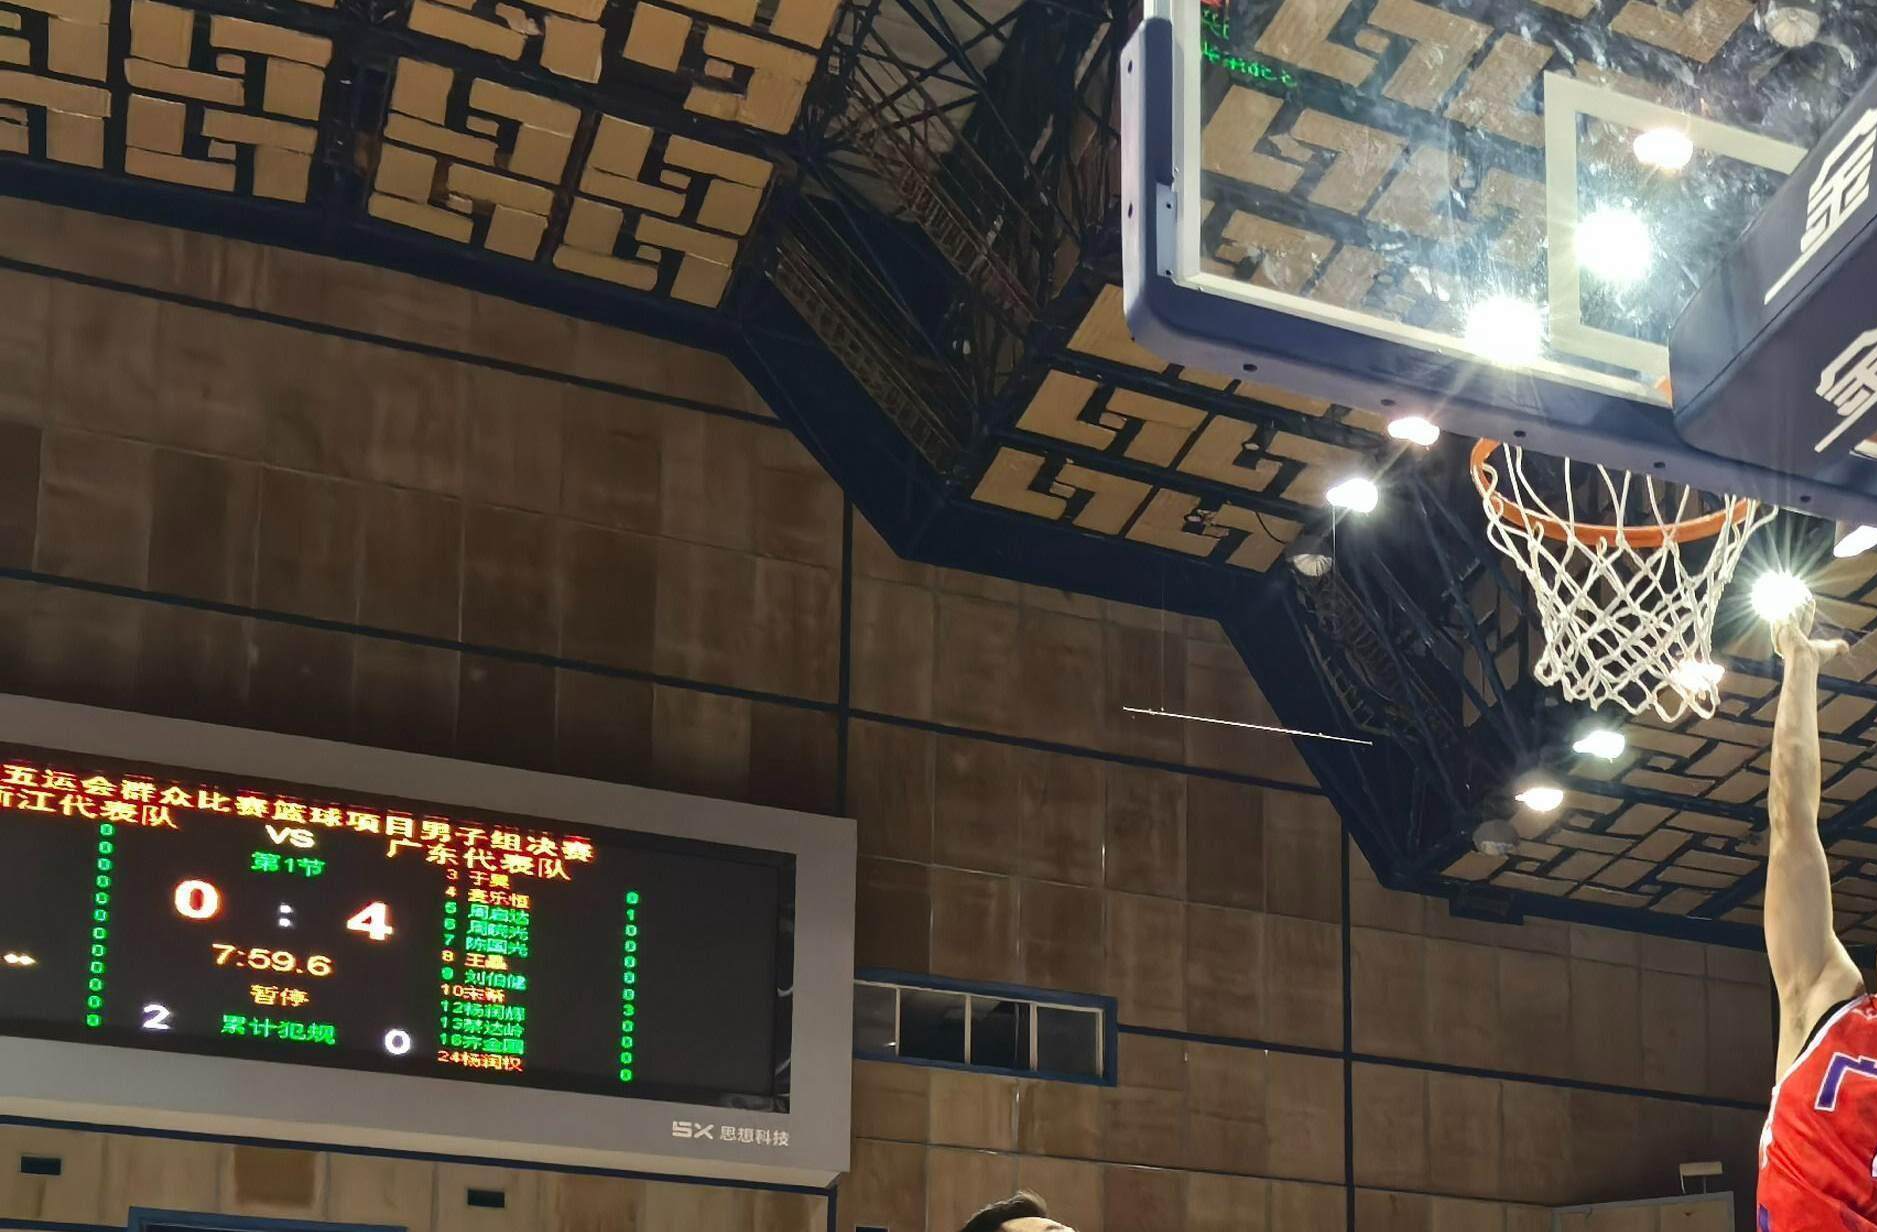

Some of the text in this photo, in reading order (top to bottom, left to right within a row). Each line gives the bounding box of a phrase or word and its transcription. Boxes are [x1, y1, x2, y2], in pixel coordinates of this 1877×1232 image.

[265, 824, 315, 848] VS
[250, 851, 326, 877] 第1节
[386, 837, 572, 881] 广东代表队
[174, 880, 220, 919] 0
[346, 901, 395, 941] 4
[212, 942, 333, 977] 7:59.6
[249, 984, 311, 1008] 暂停
[143, 1004, 411, 1055] 2 累计犯规 0
[719, 1125, 790, 1147] 思想科技
